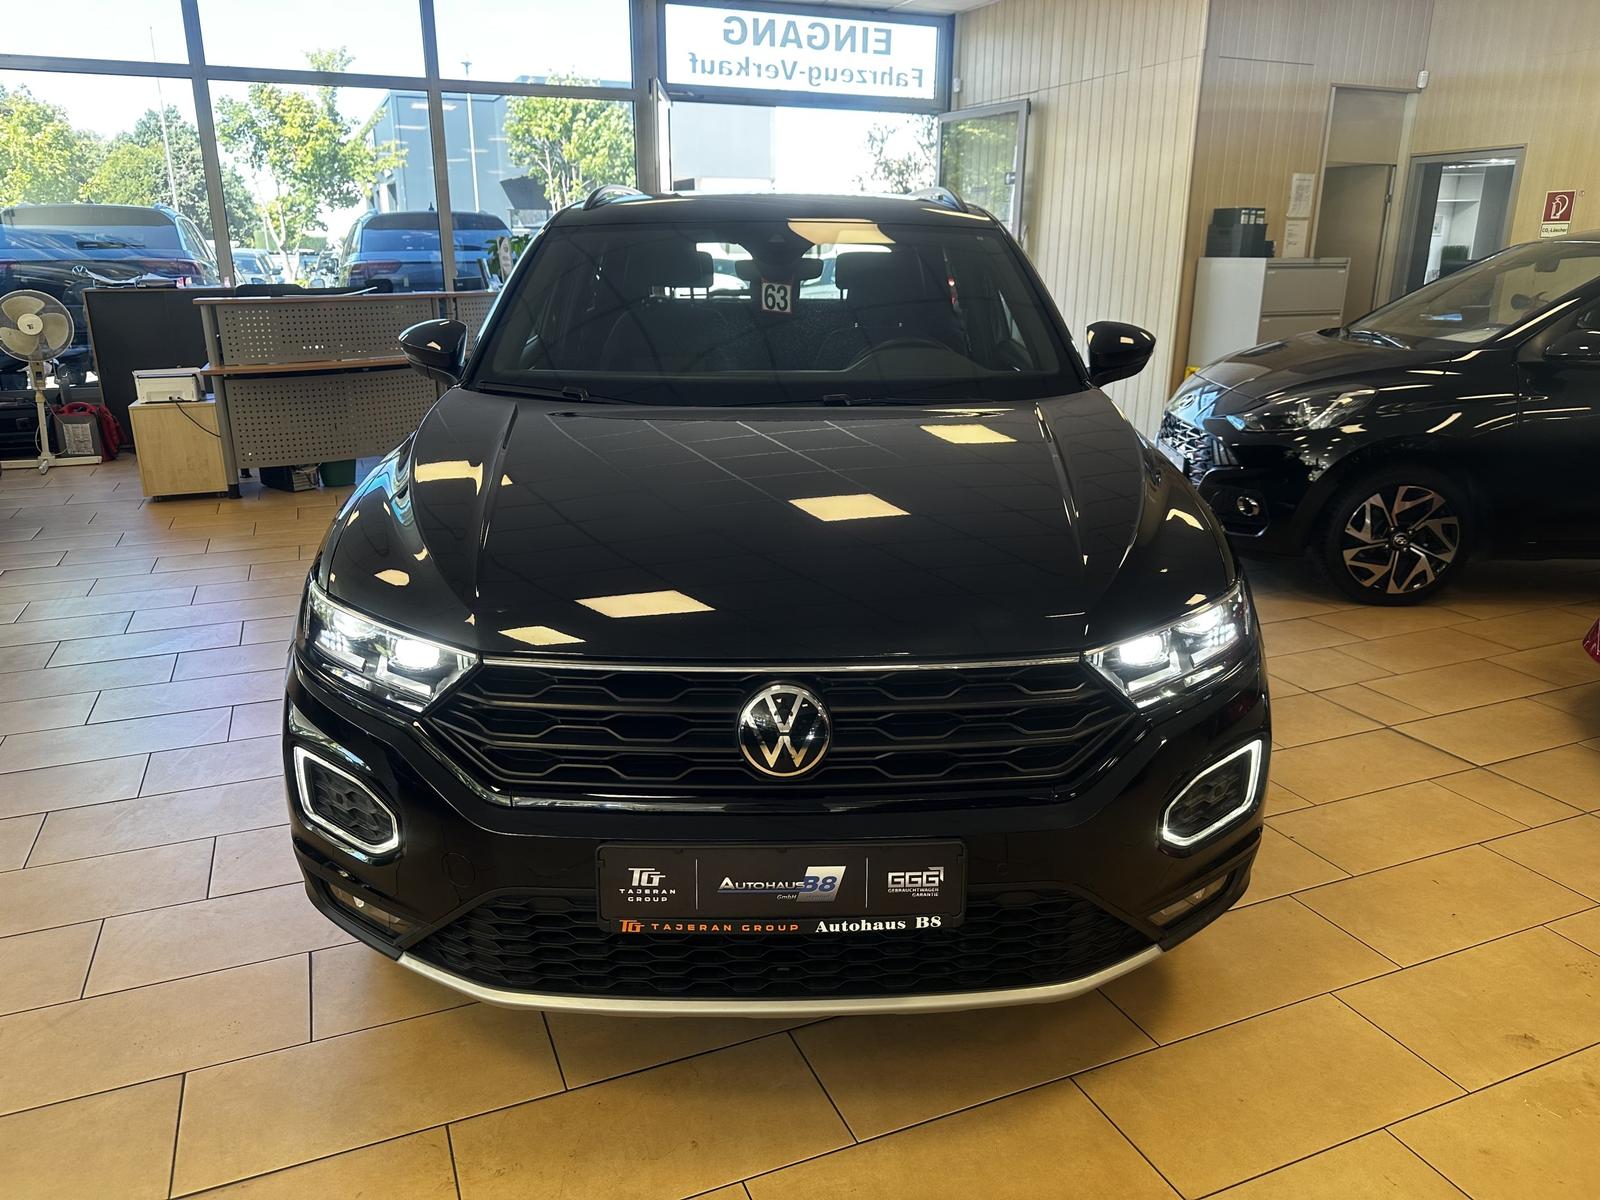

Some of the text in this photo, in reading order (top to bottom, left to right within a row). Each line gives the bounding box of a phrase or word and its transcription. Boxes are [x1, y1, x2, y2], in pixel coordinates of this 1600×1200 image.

[764, 283, 789, 312] 63
[887, 871, 940, 888] GGG
[650, 923, 732, 932] TAJERAN
[741, 924, 800, 932] GROUP
[815, 919, 906, 933] Autohaus
[916, 915, 942, 929] B8
